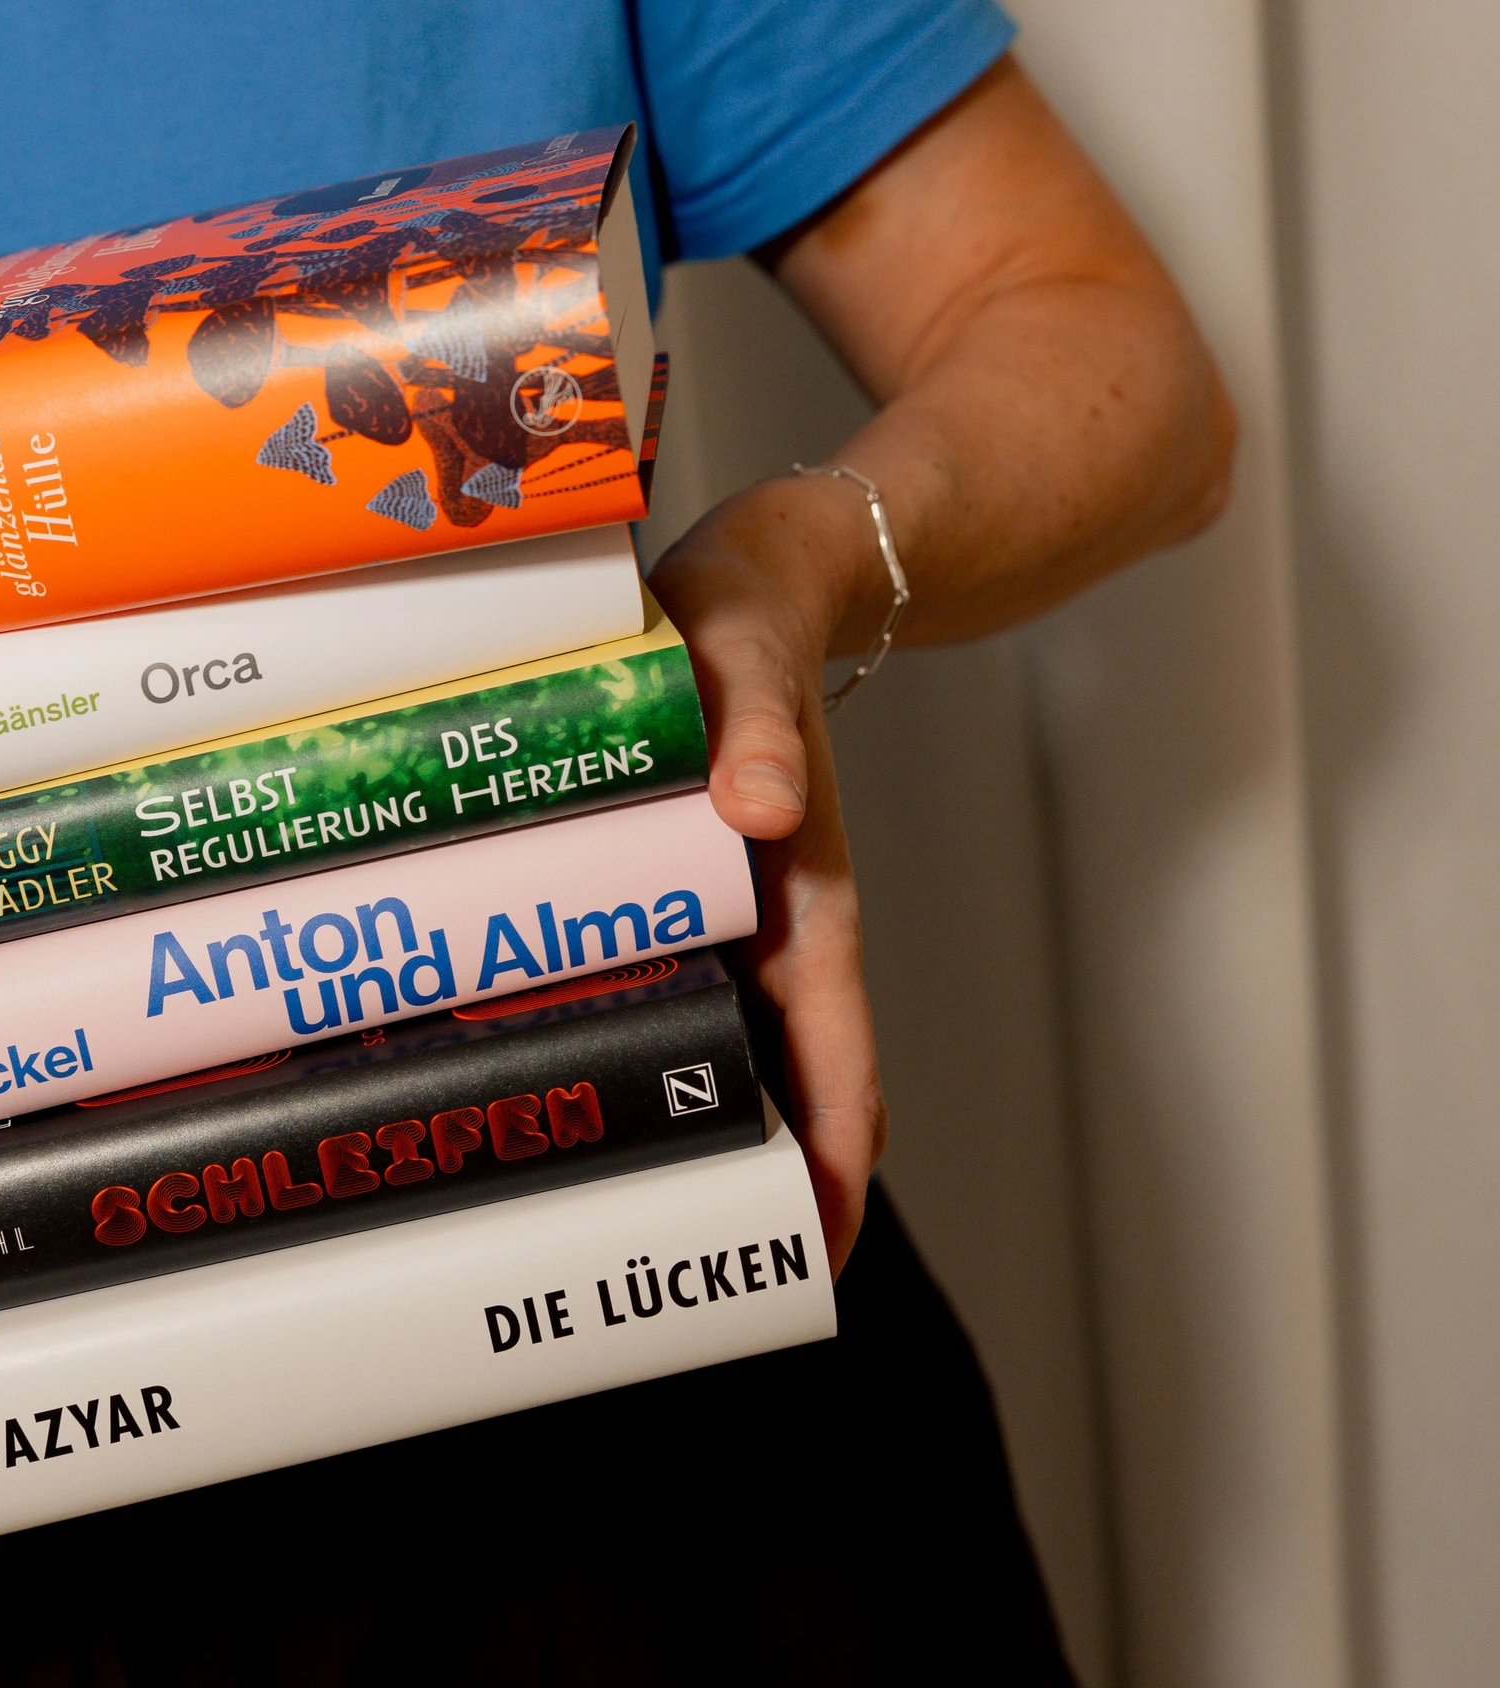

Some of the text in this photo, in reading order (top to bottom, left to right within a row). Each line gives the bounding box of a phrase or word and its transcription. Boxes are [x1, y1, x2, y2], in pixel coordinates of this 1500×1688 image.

[21, 432, 79, 548] Hülle
[139, 651, 263, 705] Orca
[439, 716, 520, 770] DES
[450, 739, 655, 815] HERZENS
[134, 766, 298, 838] SELBST
[149, 789, 428, 882] REGULIERUNG
[145, 895, 418, 1019] Anton
[280, 888, 707, 1036] und Alma
[90, 1081, 605, 1247] SCHLEIFEN
[483, 1232, 810, 1354] DIE LÜCKEN
